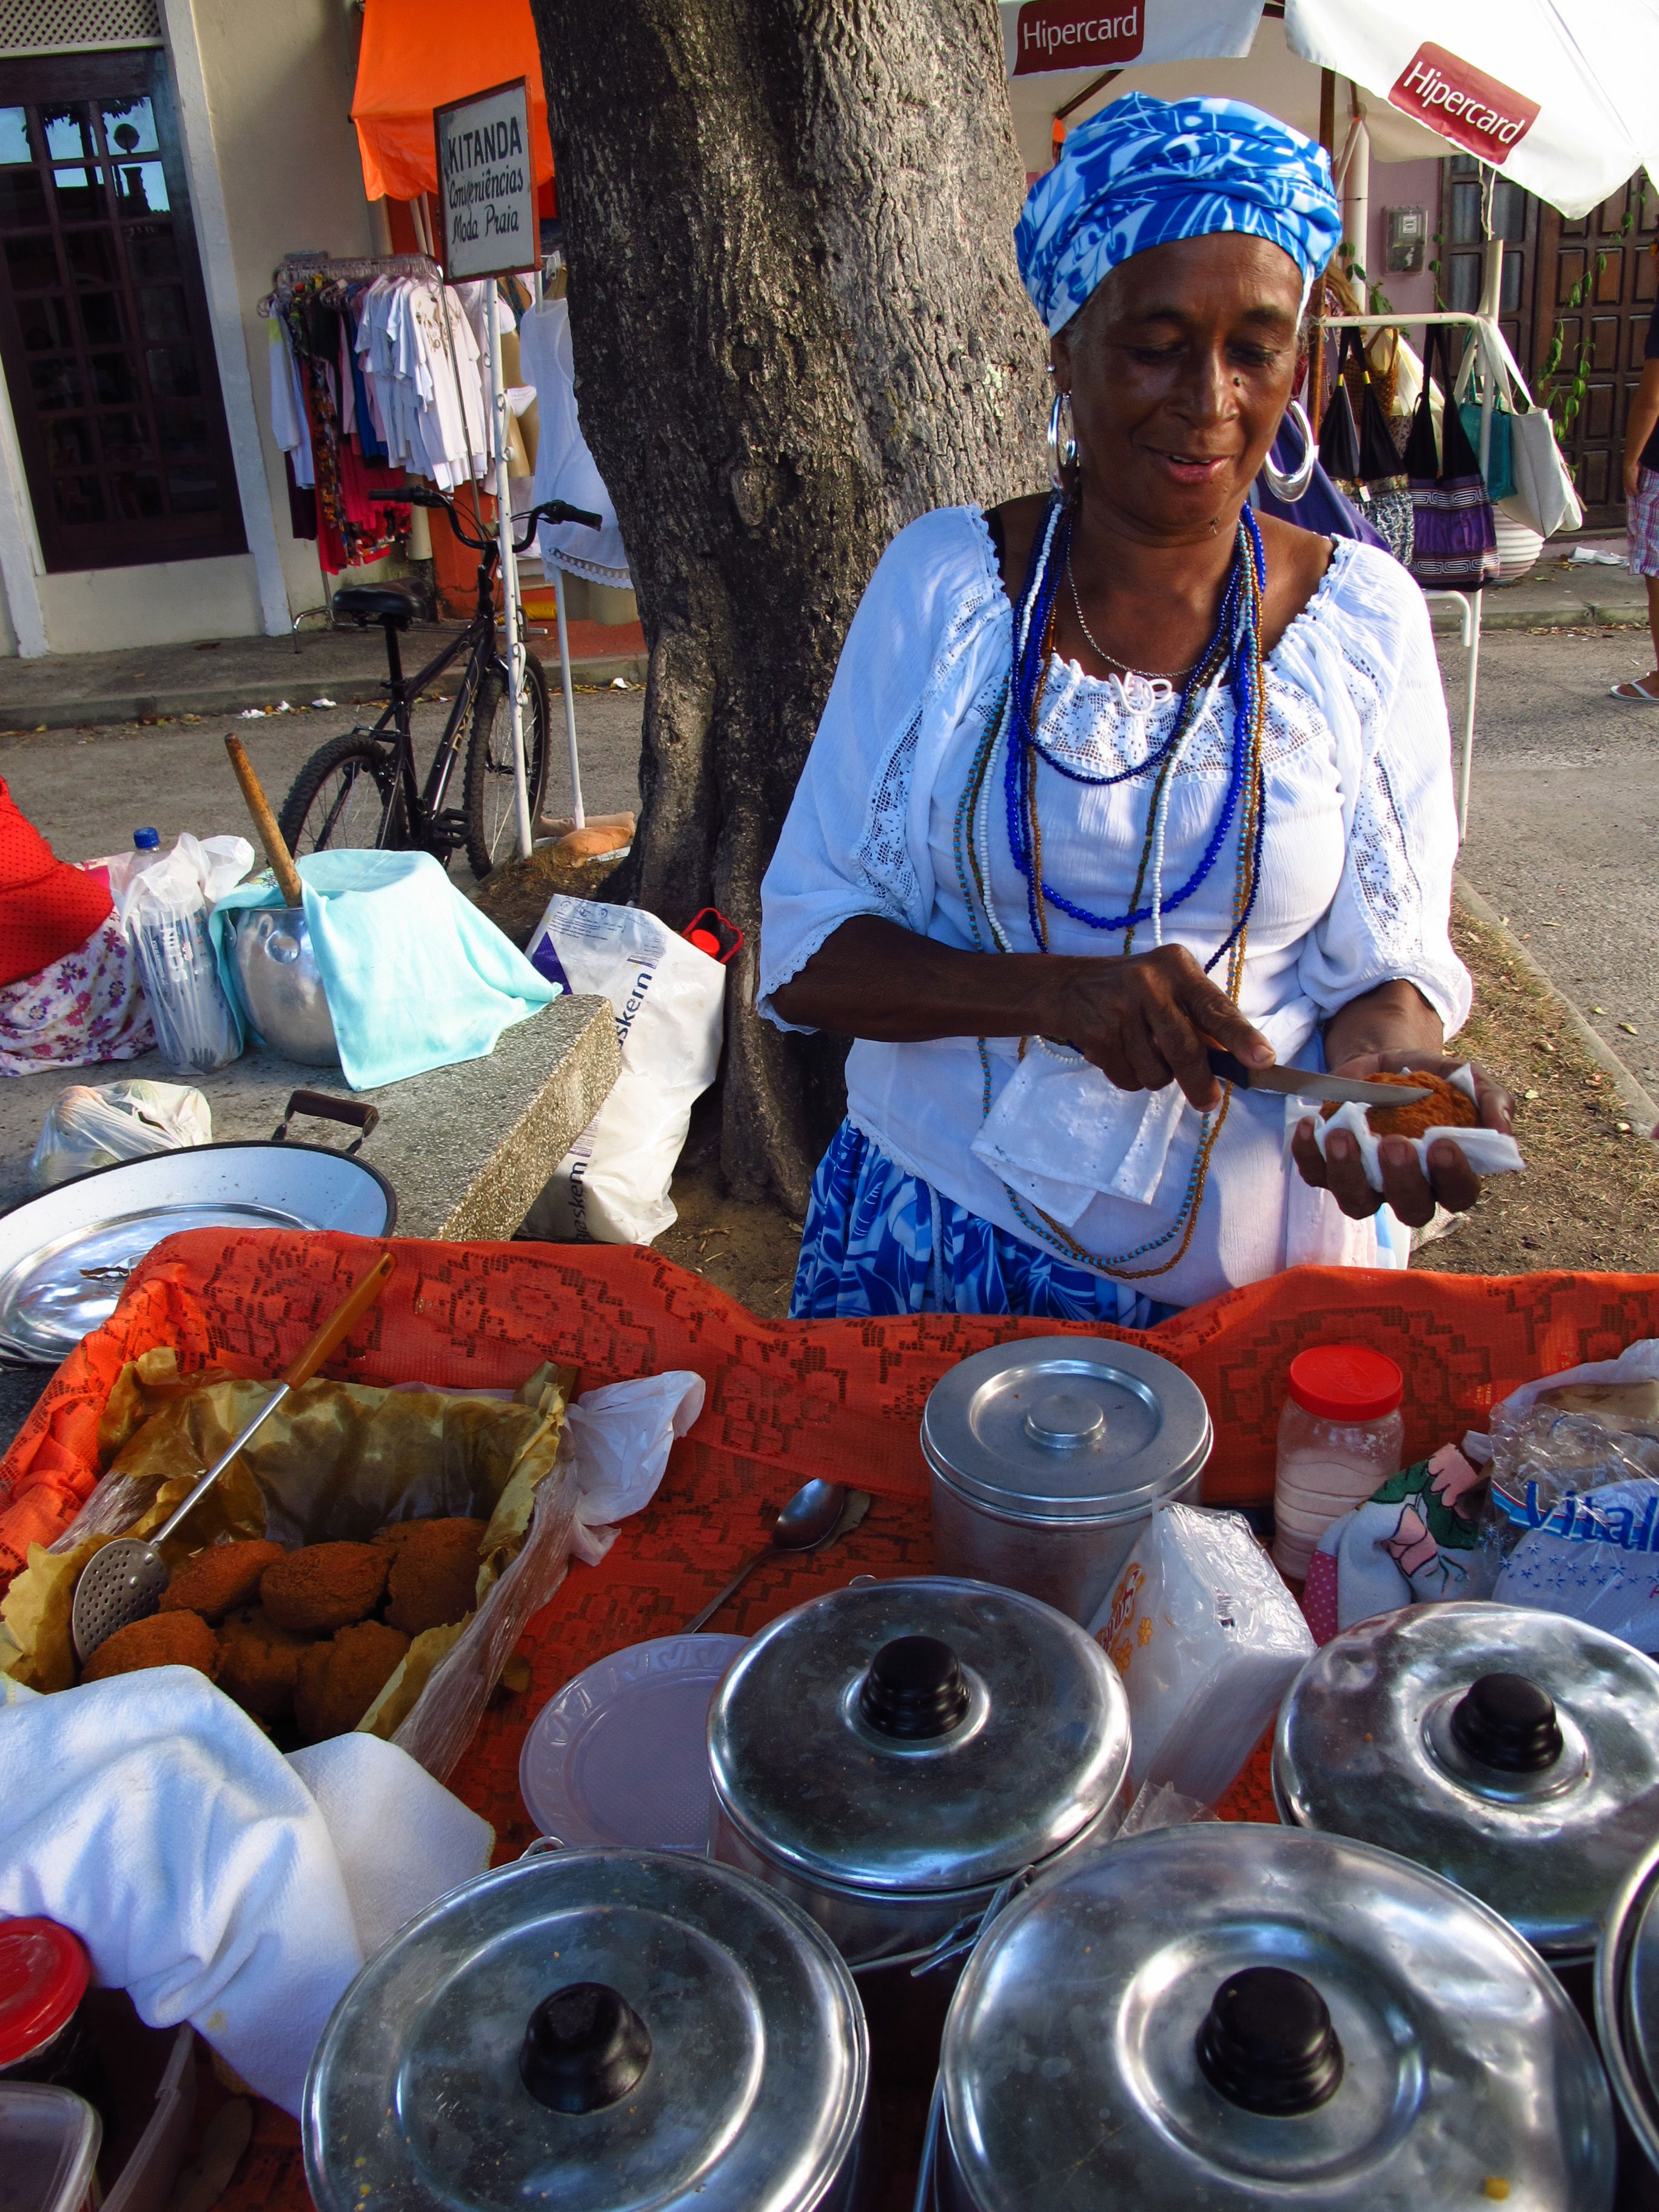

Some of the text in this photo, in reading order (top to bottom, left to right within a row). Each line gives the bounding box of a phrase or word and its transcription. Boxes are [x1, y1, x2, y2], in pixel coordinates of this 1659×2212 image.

[1023, 5, 1138, 55] Hipercard
[1403, 61, 1526, 144] Hipercard
[449, 116, 522, 175] KITANDA
[449, 164, 523, 210] Conveniências
[452, 204, 519, 244] Moda Praia
[1526, 1480, 1659, 1552] Vital
